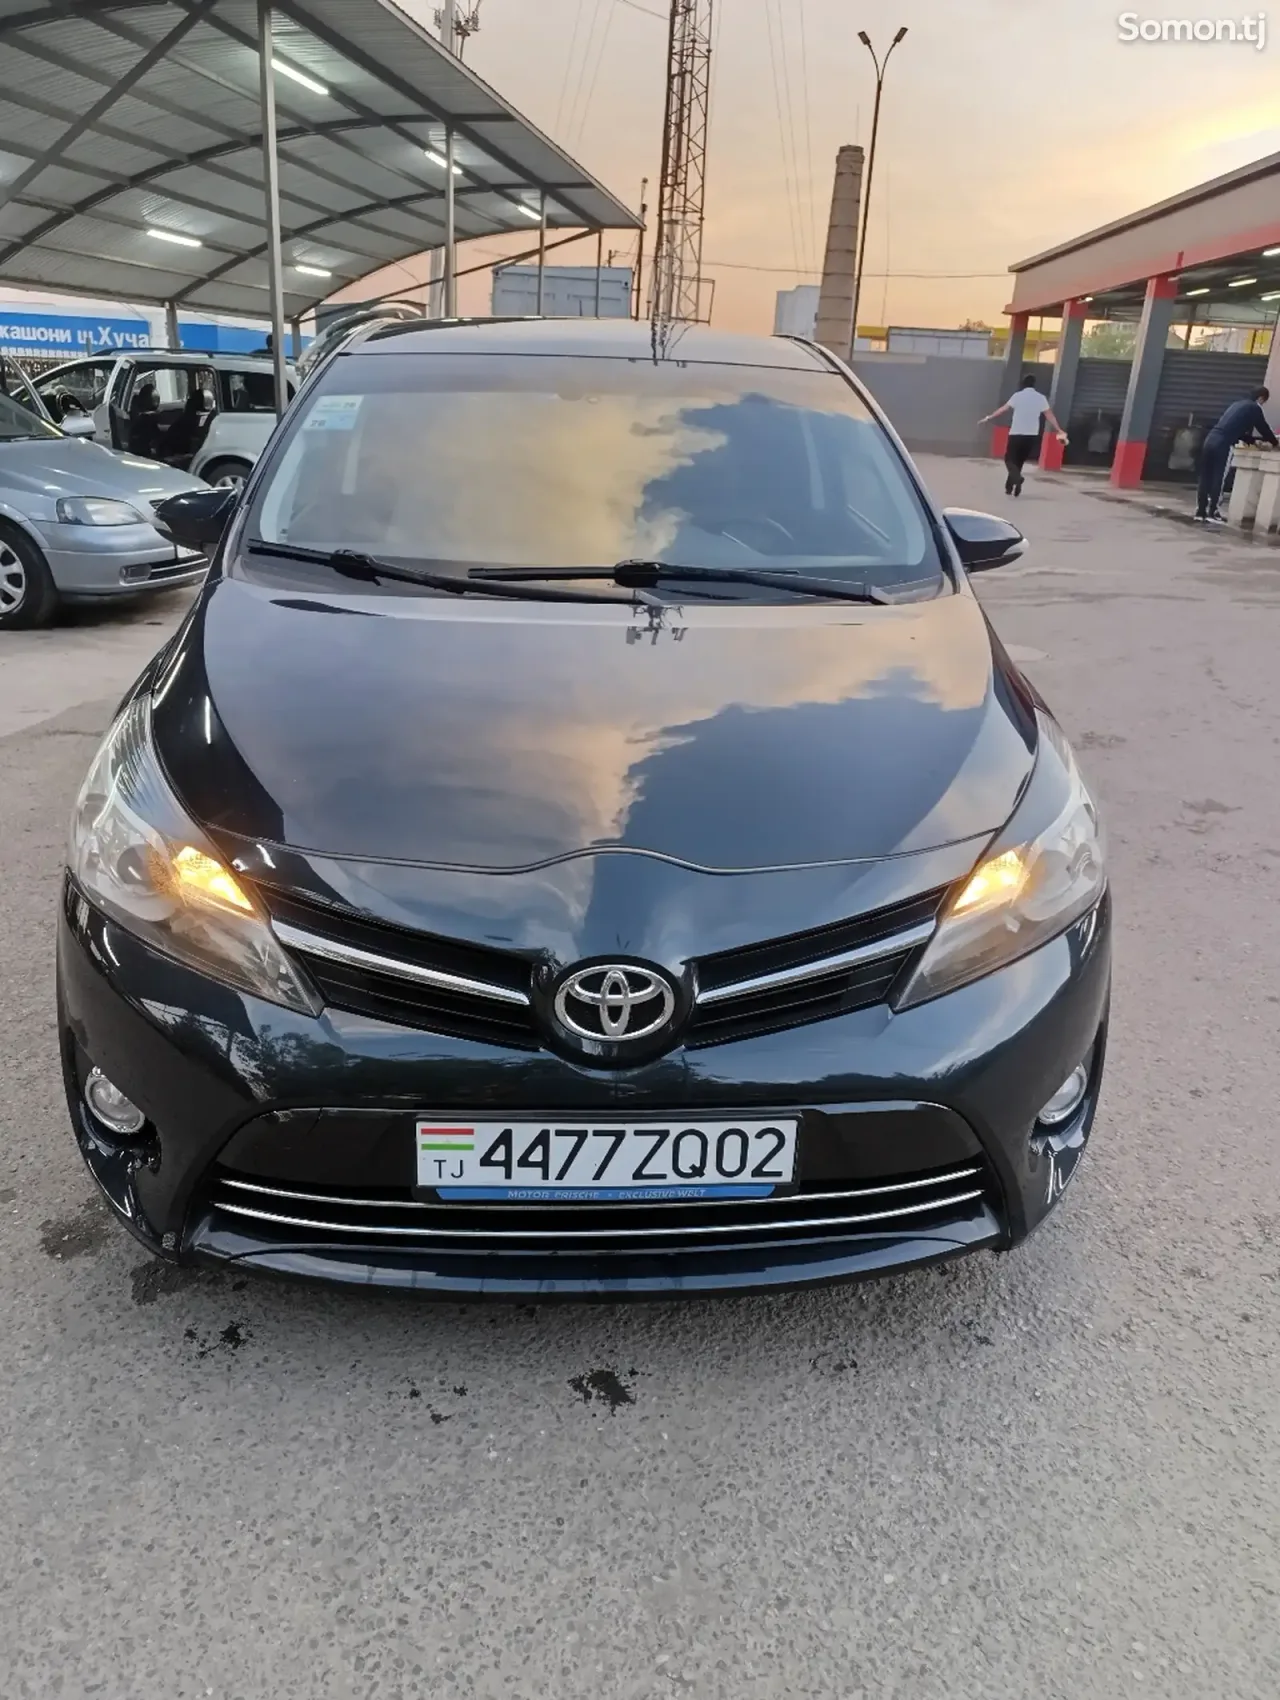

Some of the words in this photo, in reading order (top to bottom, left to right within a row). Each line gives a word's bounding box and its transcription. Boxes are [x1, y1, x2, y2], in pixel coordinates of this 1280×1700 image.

[434, 1159, 464, 1179] TJ
[479, 1127, 786, 1181] 4477ZQ02
[507, 1190, 550, 1199] MOTOR
[618, 1189, 674, 1199] EXCLUSIVE
[677, 1187, 706, 1197] WELT
